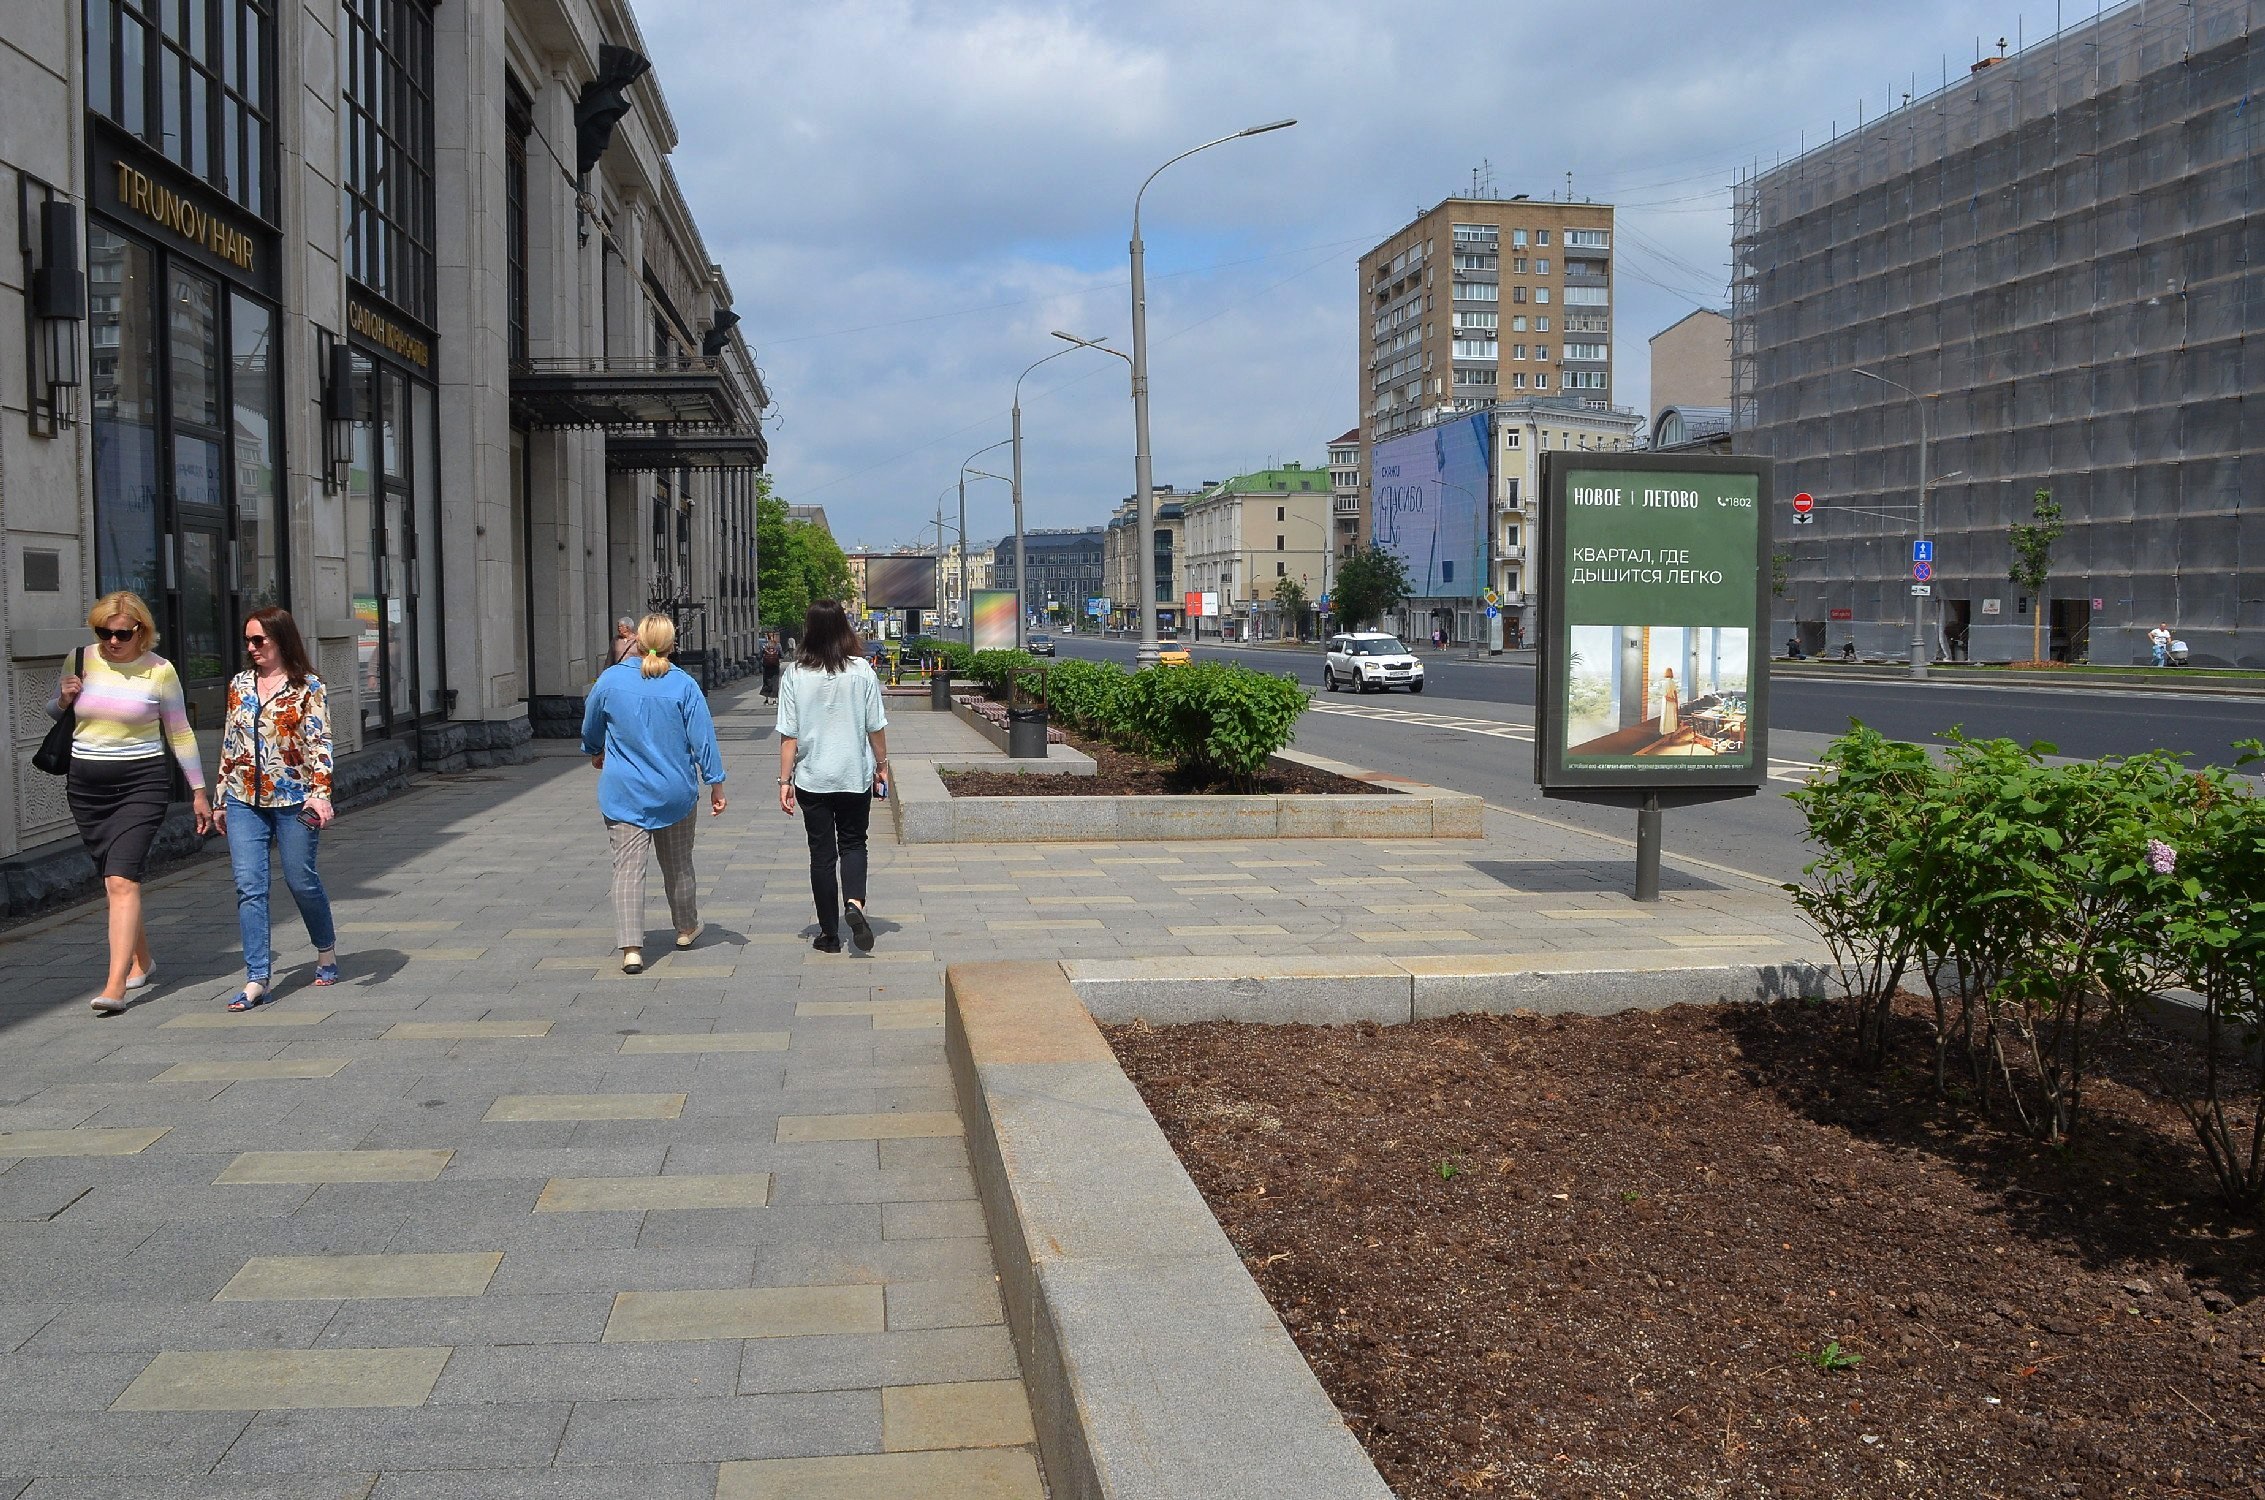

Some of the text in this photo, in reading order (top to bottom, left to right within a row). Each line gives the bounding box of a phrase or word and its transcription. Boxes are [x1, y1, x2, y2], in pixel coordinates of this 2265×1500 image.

[113, 160, 254, 272] TRUNOV HAIR
[349, 300, 385, 344] САЛОН
[1574, 487, 1699, 509] НОВОЕ ЛЕТОВО
[1573, 547, 1689, 566] КВАРТАЛ, ГДЕ
[1571, 568, 1723, 584] ДЫШИТСЯ ЛЕГКО
[1712, 740, 1744, 750] РОСТ
